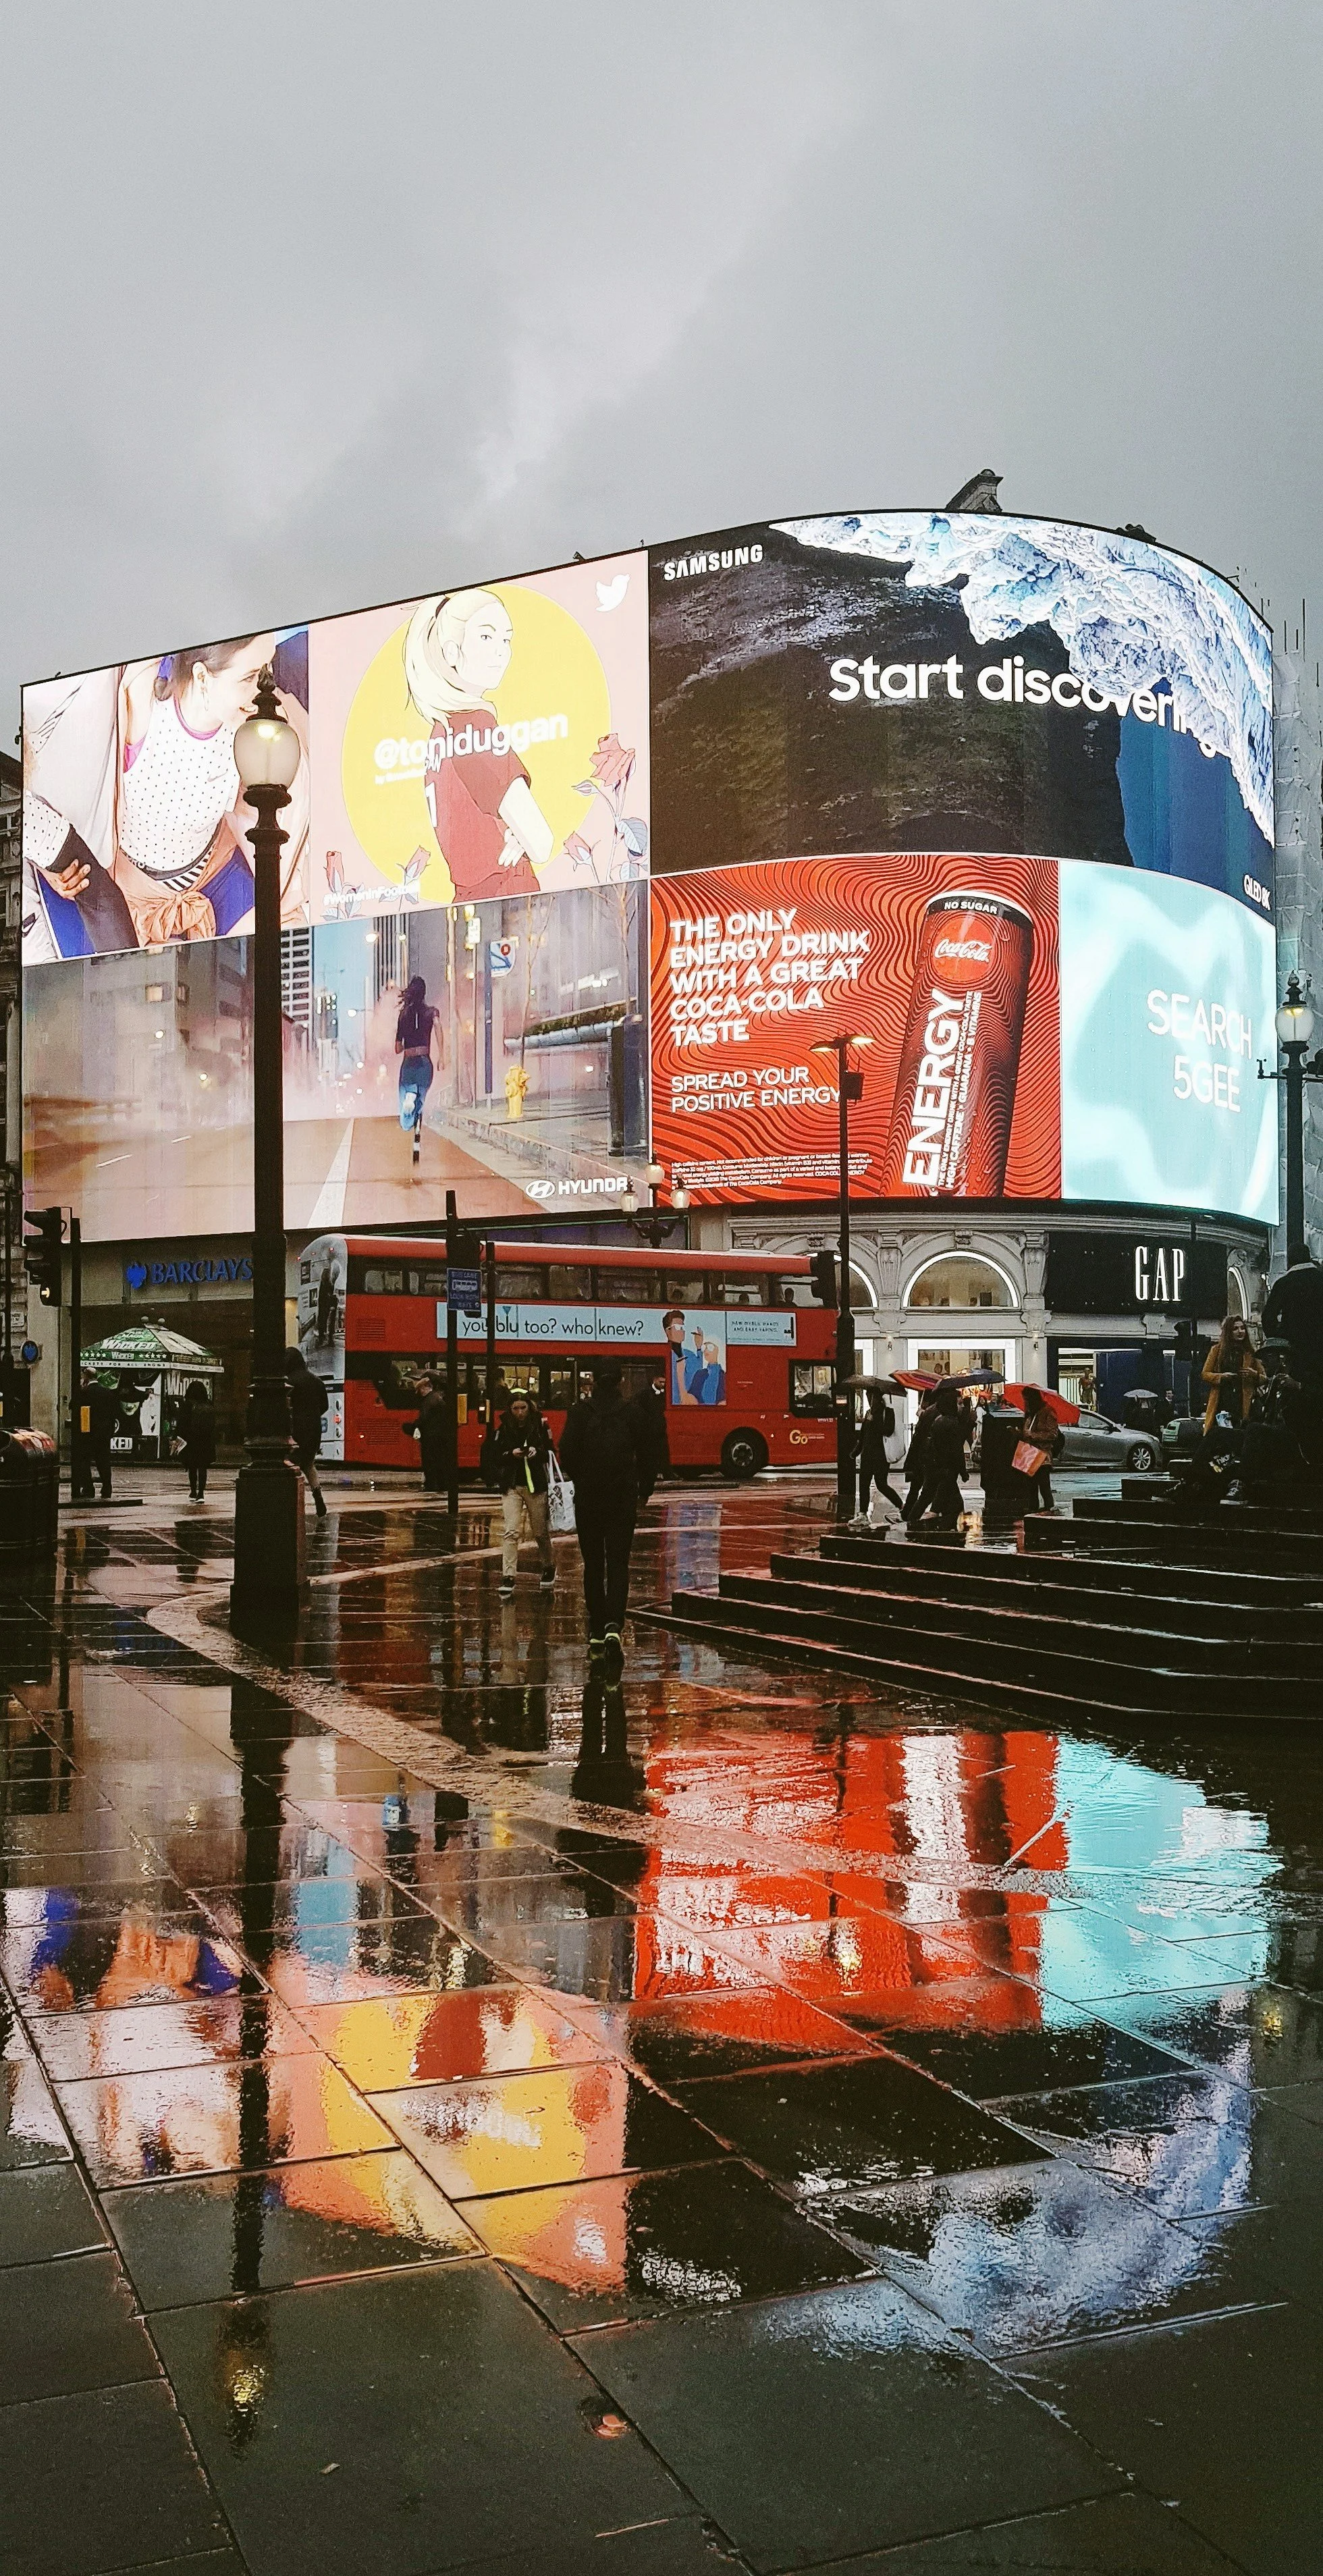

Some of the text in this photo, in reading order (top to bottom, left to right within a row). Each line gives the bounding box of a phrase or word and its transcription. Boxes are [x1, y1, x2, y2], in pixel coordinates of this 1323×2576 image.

[664, 545, 763, 581] SAMSUNG
[829, 654, 963, 703] Start
[374, 714, 568, 770] @toniduggan
[670, 908, 797, 942] THE ONLY
[944, 901, 998, 915] NO SUGAR
[670, 930, 871, 969] ENERGY DRINK
[670, 958, 863, 994] WITH A GREAT
[669, 987, 826, 1021] COCA-COLA
[967, 991, 982, 1036] VITAMINS
[669, 1019, 750, 1047] TASTE
[1147, 989, 1251, 1060] SEARCH
[670, 1066, 809, 1093] SPREAD YOUR
[902, 988, 965, 1187] ENERGY
[958, 1054, 973, 1104] GUARANA
[1173, 1054, 1241, 1112] 5GEE
[671, 1085, 840, 1113] POSITIVE ENERGY
[950, 1111, 965, 1161] CAFFEINE
[558, 1176, 629, 1195] HYUNDA
[945, 1161, 957, 1189] HIGH
[151, 1258, 253, 1283] BARCLAYS
[1135, 1245, 1185, 1302] GAP
[462, 1315, 644, 1336] you blu too? who knew?
[789, 1429, 809, 1445] Go
